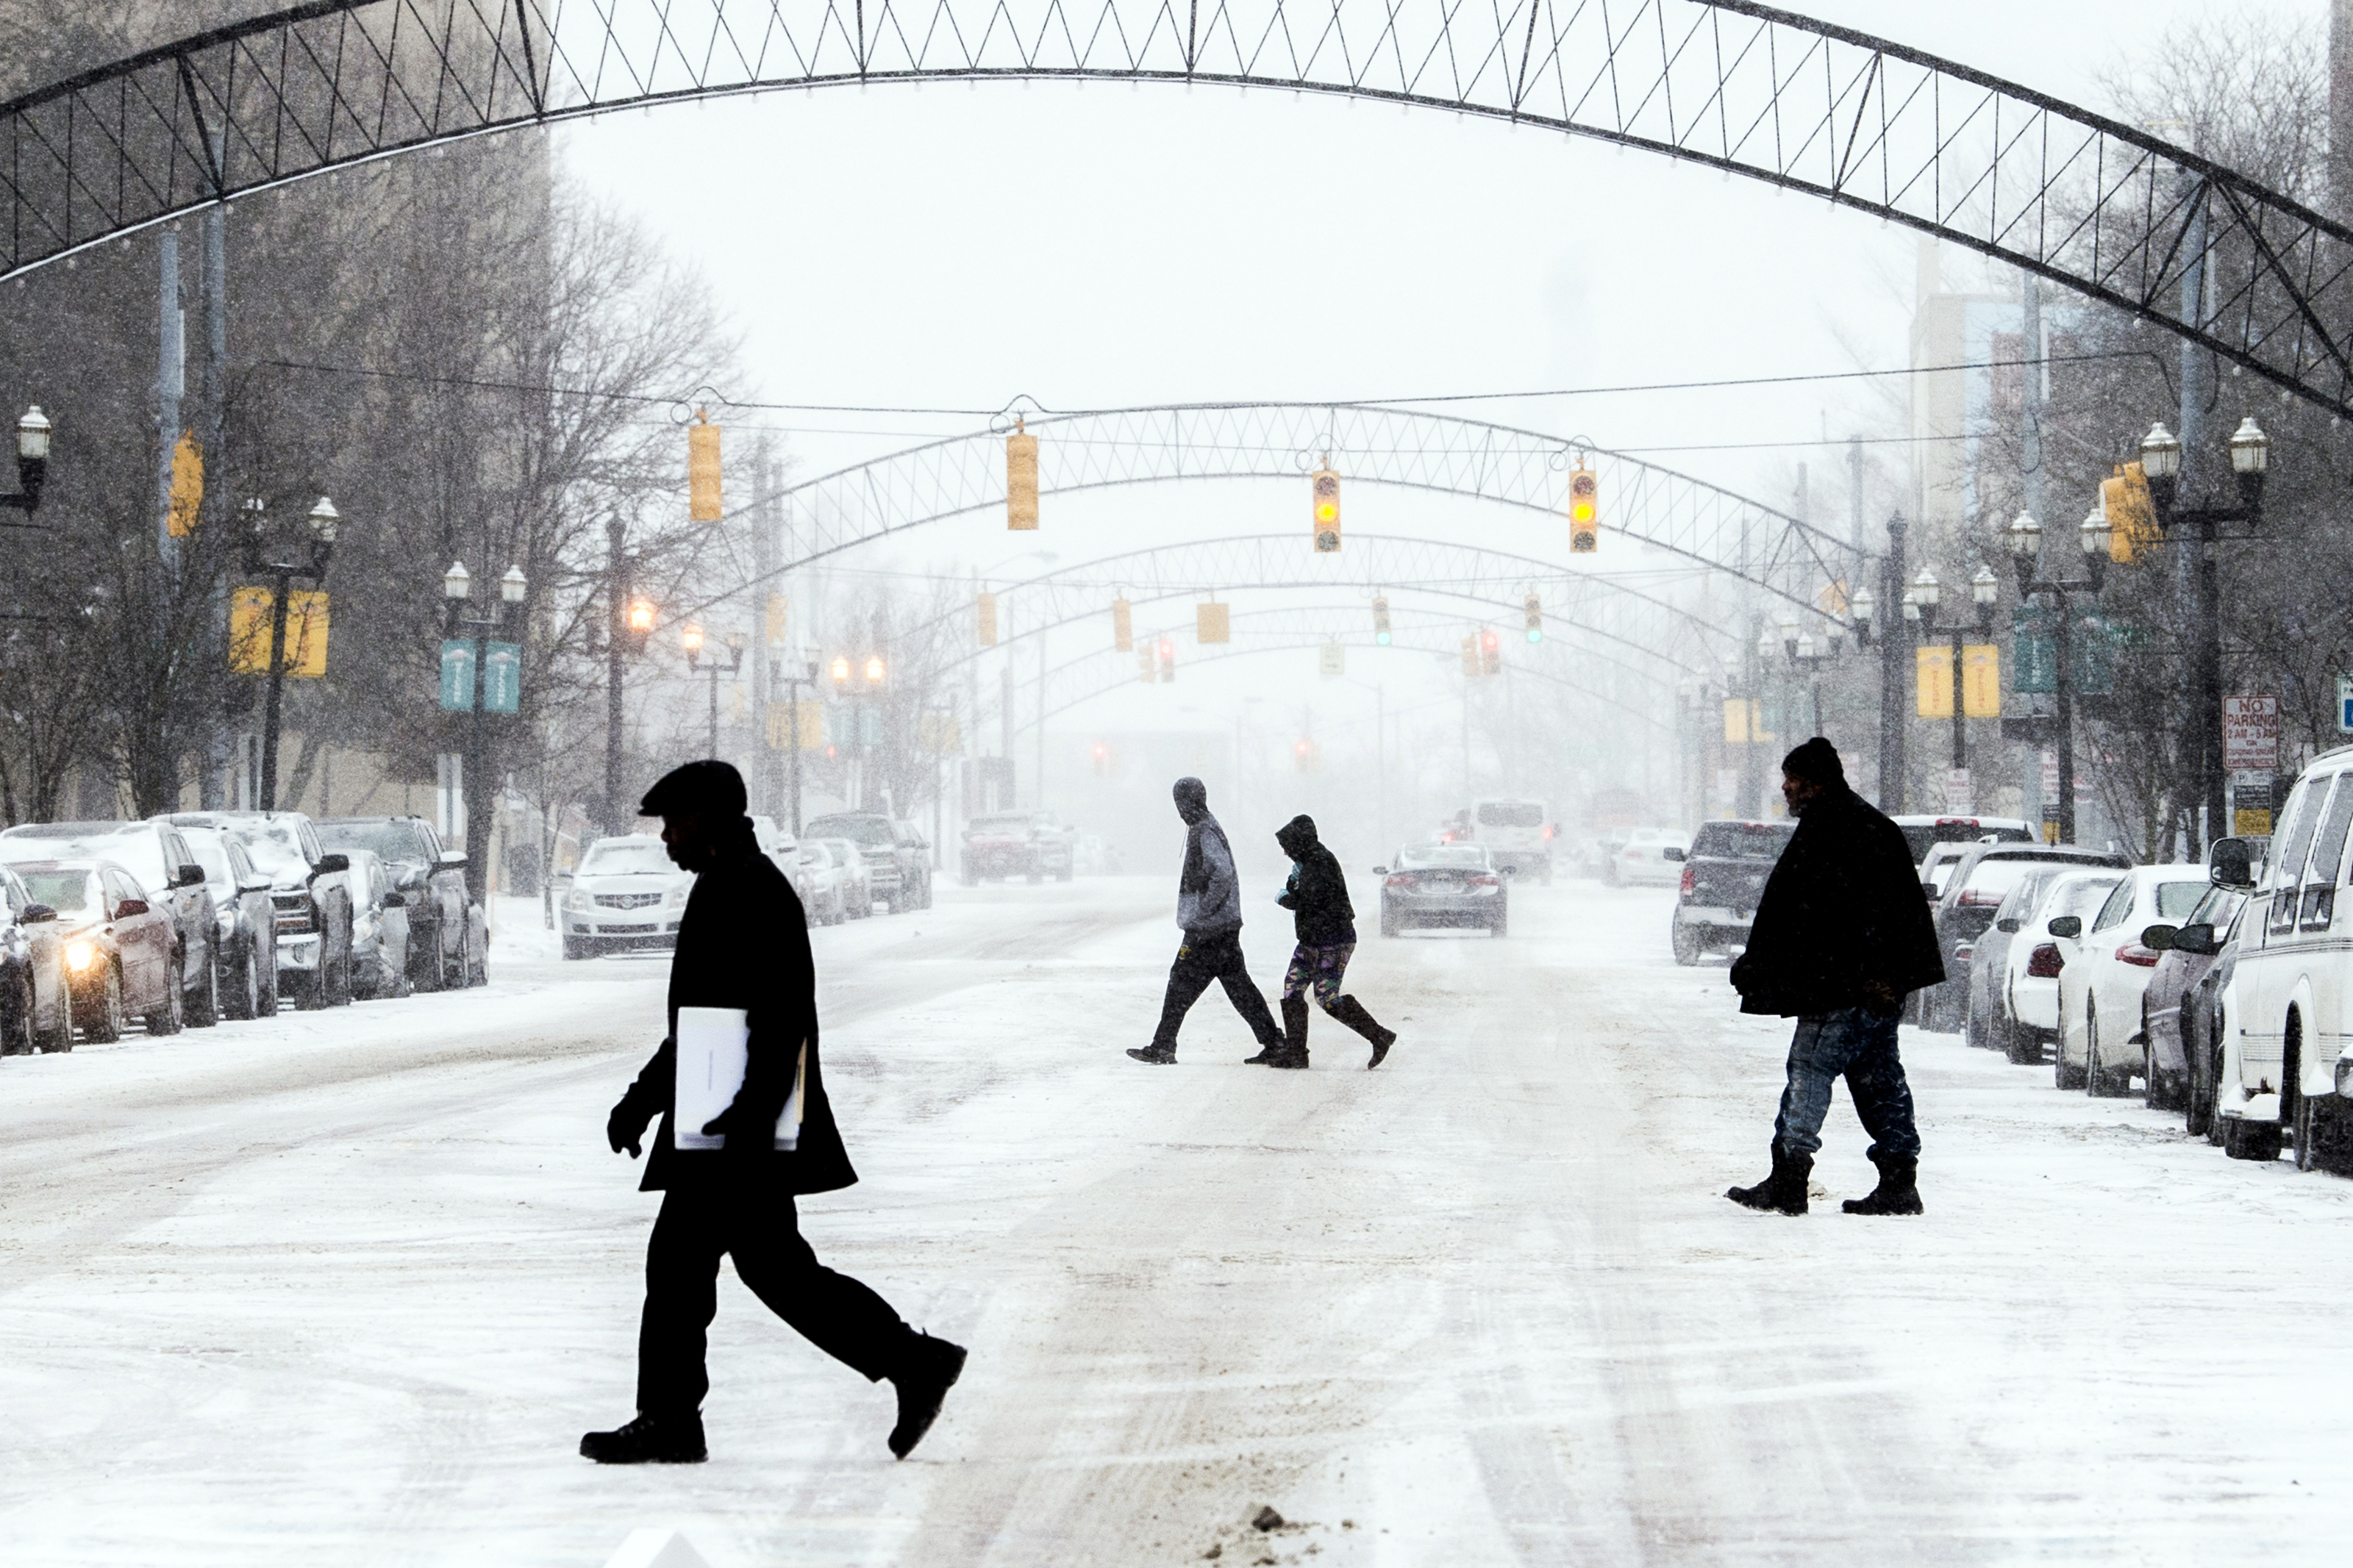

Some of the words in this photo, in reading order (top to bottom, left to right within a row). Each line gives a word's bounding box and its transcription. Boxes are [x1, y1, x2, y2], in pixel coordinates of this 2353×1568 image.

[2238, 700, 2263, 712] NO
[2227, 714, 2276, 727] PARKING
[2227, 728, 2232, 739] 2
[2235, 728, 2247, 739] AM
